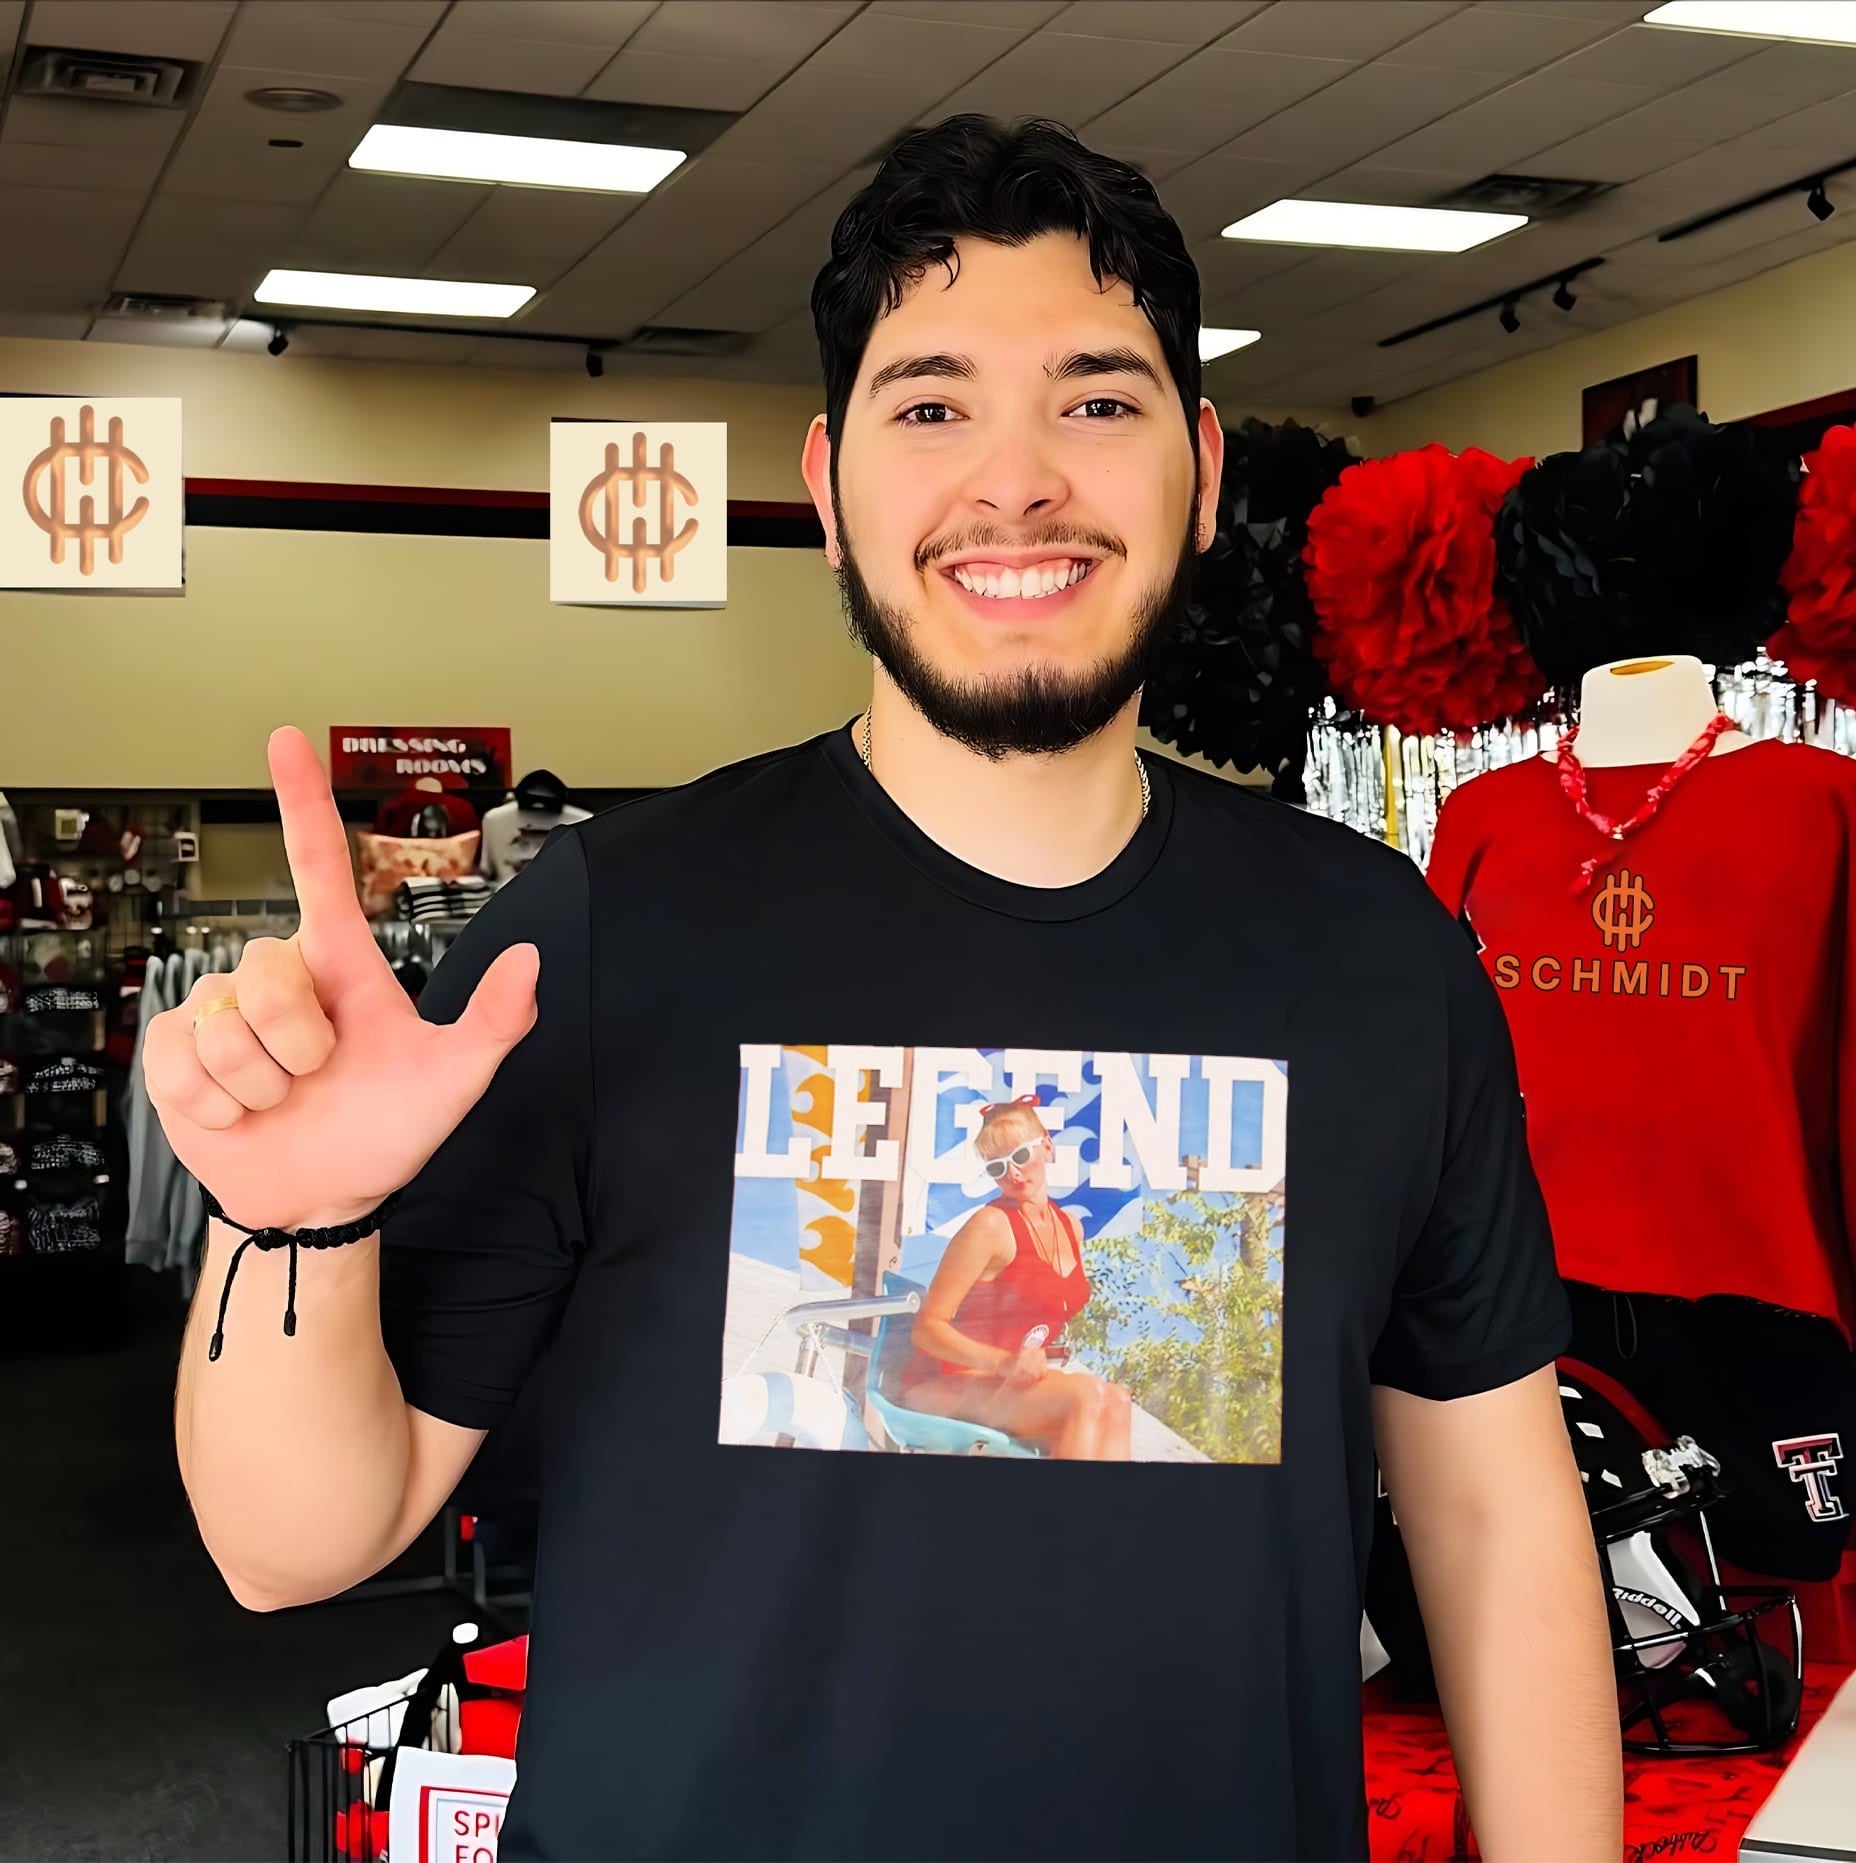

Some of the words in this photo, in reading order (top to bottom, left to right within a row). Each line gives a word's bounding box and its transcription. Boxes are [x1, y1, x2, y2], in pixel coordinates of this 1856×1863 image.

[342, 737, 467, 754] DRESSING
[396, 758, 487, 775] ROOMS
[1494, 953, 1747, 1000] SCHMIDT
[734, 1044, 1288, 1194] LEGEND
